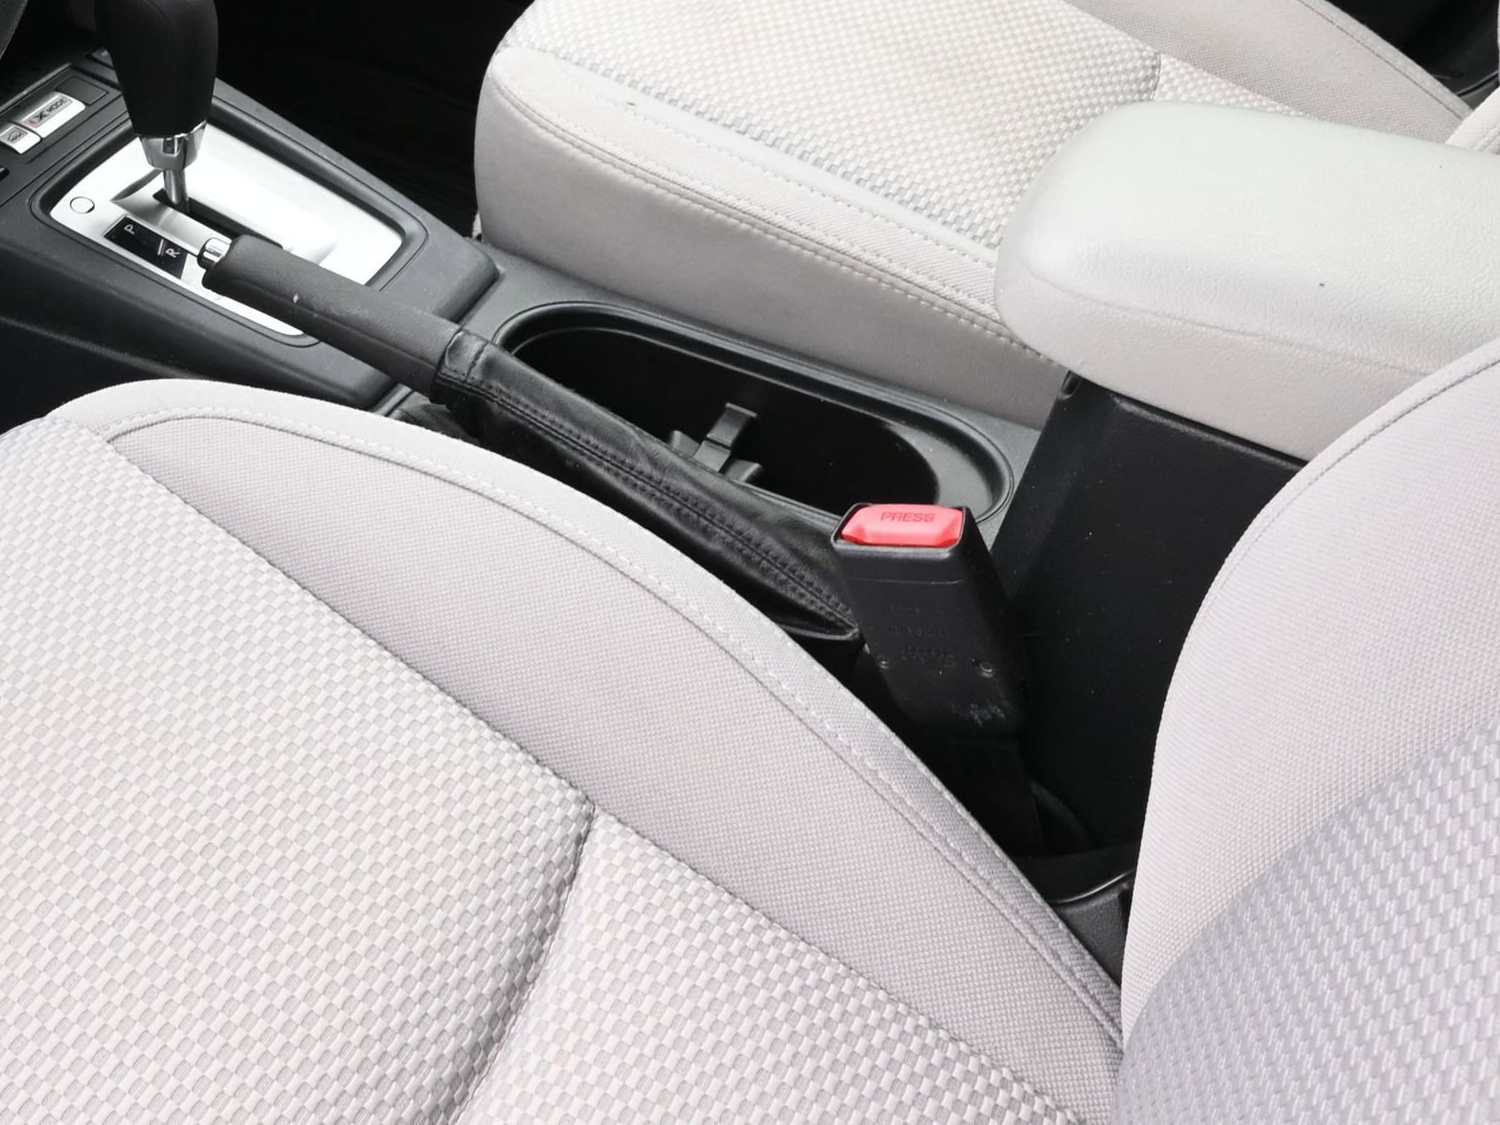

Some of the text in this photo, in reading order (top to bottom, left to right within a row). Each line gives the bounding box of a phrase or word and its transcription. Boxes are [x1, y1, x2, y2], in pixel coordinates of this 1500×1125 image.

[123, 223, 136, 236] P
[165, 247, 181, 259] R
[880, 511, 936, 524] PRESS
